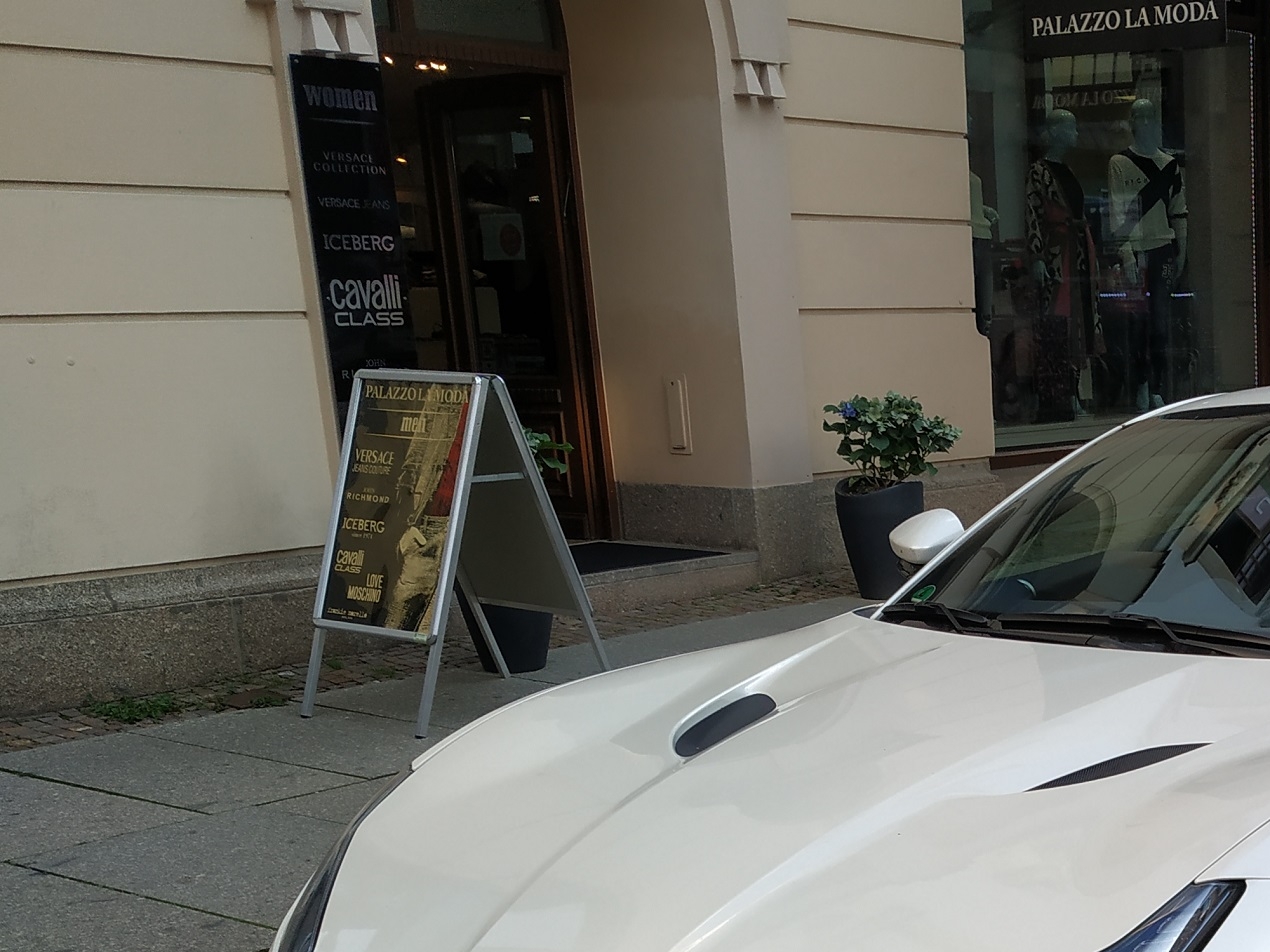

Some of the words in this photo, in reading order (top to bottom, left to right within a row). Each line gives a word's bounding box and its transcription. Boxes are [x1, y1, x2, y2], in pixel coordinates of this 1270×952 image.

[1031, 10, 1121, 37] PALAZZO
[1125, 7, 1151, 29] LA
[1154, 0, 1219, 26] MODA
[303, 84, 378, 111] women
[323, 151, 375, 163] VERSACE
[313, 162, 387, 175] COLLECTION
[318, 196, 360, 209] VERSACE
[362, 200, 391, 210] JEANS
[323, 233, 395, 252] ICEBERG
[329, 273, 403, 310] cavalli
[334, 311, 405, 327] CLASS
[365, 384, 417, 400] PALAZZO
[400, 416, 427, 433] men
[355, 448, 395, 465] VERSACE
[346, 492, 390, 504] RICHMOND
[342, 517, 385, 534] ICEBERG
[334, 563, 362, 574] CLASS
[366, 573, 384, 589] LOVE
[347, 585, 382, 603] MOSCHINO
